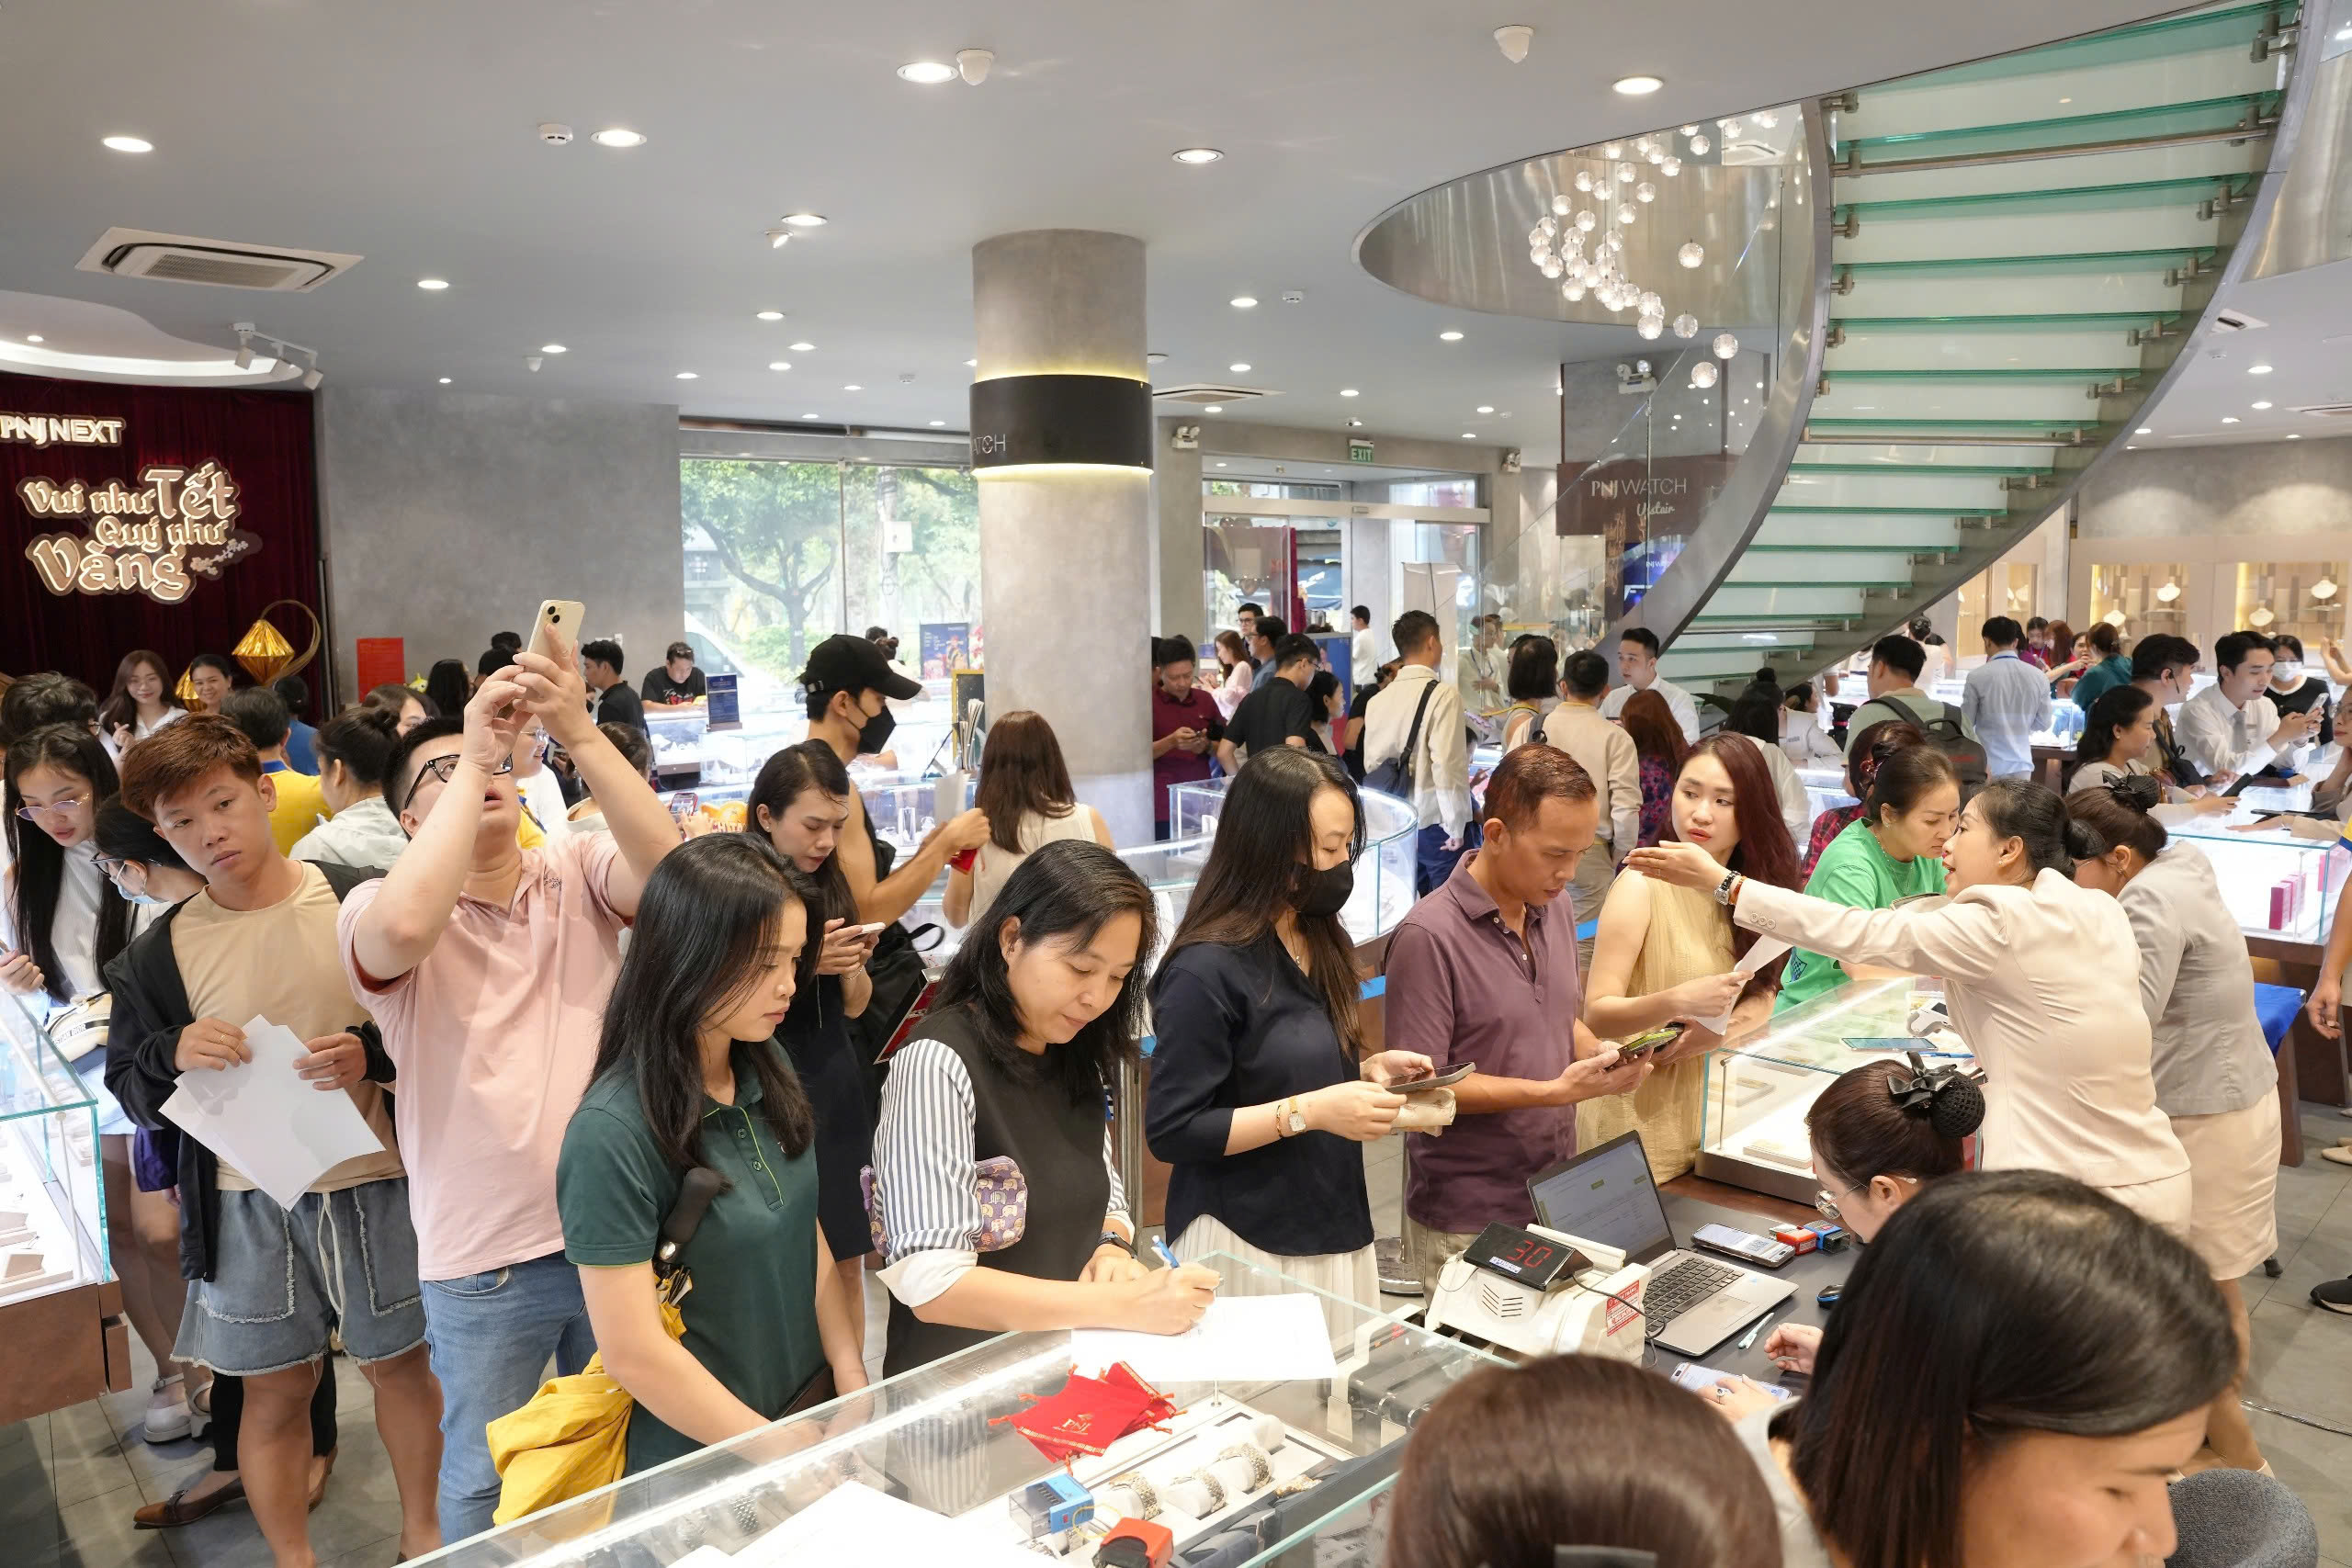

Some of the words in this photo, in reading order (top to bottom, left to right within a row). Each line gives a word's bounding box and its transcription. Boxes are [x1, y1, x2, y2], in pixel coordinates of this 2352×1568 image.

[0, 415, 47, 445] PNJ
[50, 418, 122, 443] NEXT
[1351, 447, 1372, 460] EXIT
[24, 480, 86, 513] Vui
[89, 482, 157, 514] như
[145, 462, 236, 519] Tết
[1591, 479, 1618, 499] PNJ
[1621, 478, 1687, 495] WATCH
[96, 514, 164, 553] Quý
[166, 514, 229, 546] như
[33, 536, 191, 601] Vàng
[1507, 1239, 1554, 1269] 30
